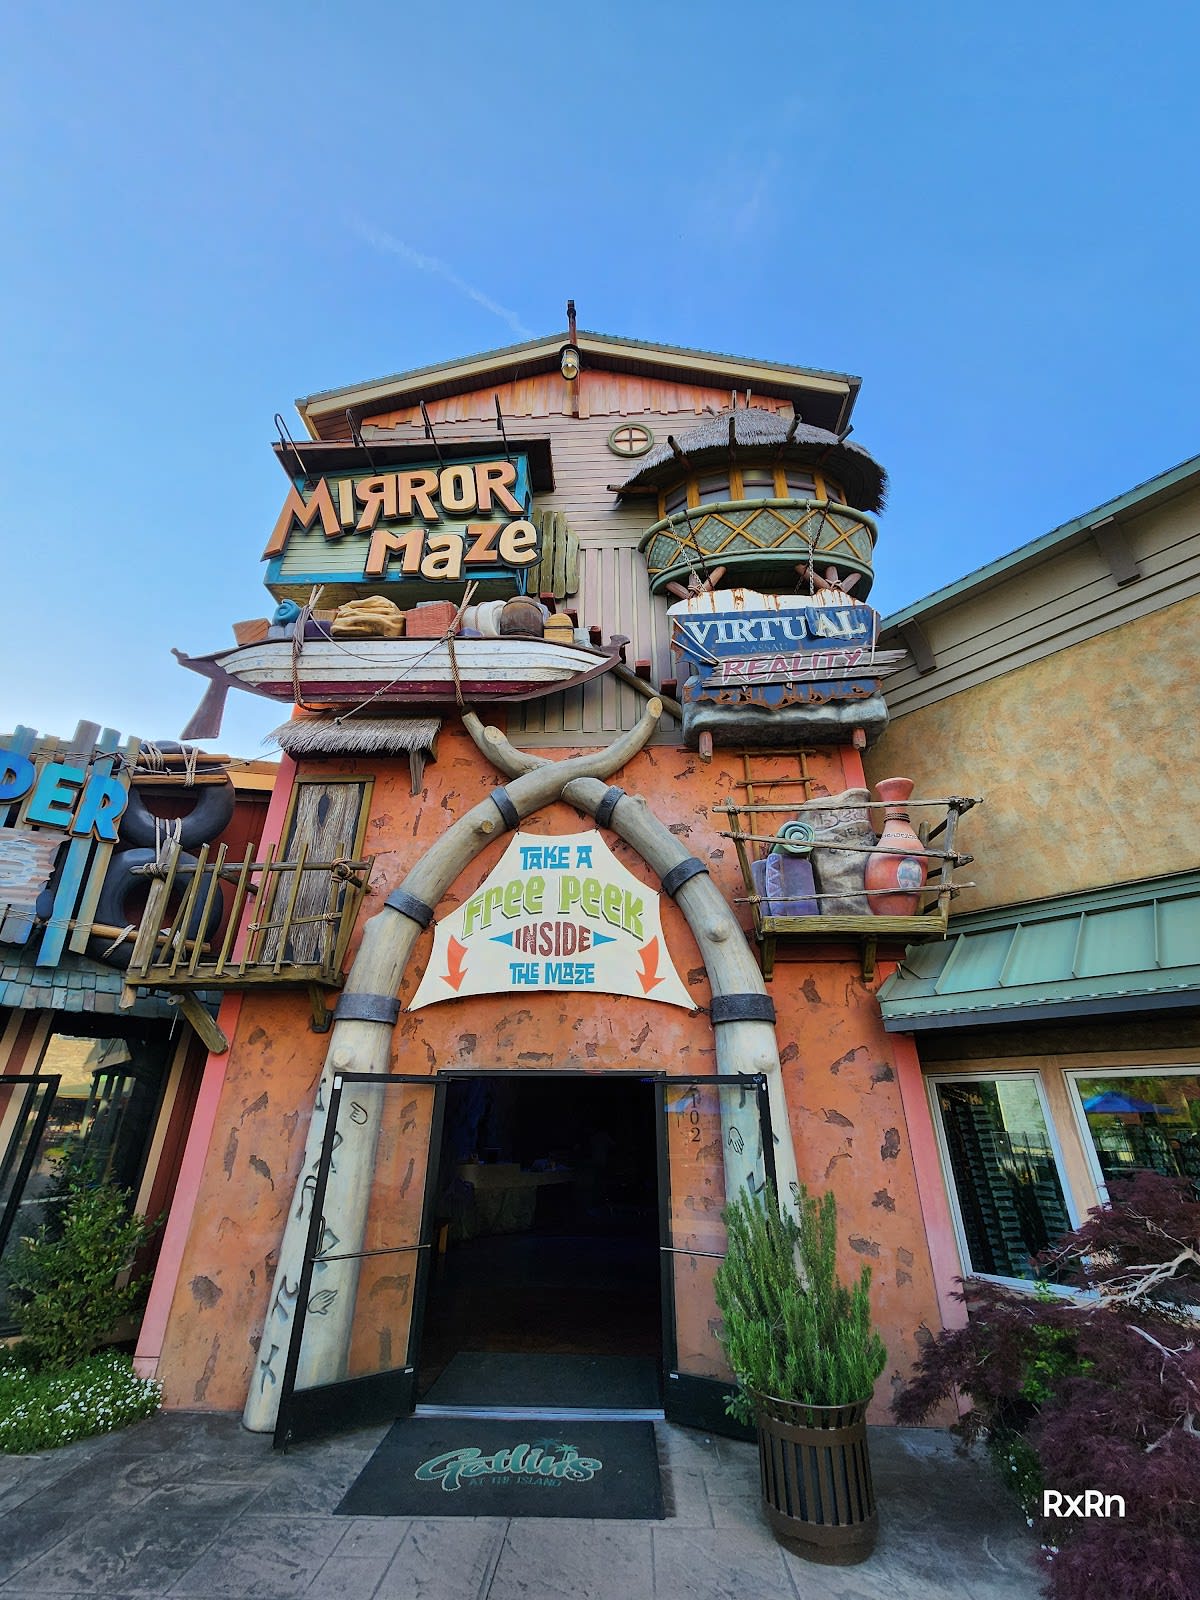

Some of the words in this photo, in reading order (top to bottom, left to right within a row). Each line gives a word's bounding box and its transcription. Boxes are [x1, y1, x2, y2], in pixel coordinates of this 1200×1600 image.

[261, 462, 525, 560] MIRROR
[364, 520, 540, 581] Maze
[684, 610, 867, 644] VIRTUAL
[722, 648, 863, 685] REALITY
[520, 846, 569, 870] TAKE
[576, 845, 593, 869] A
[514, 921, 592, 957] INSIDE
[510, 963, 540, 985] THE
[545, 963, 595, 985] MAZE
[516, 1476, 562, 1488] ISLAND
